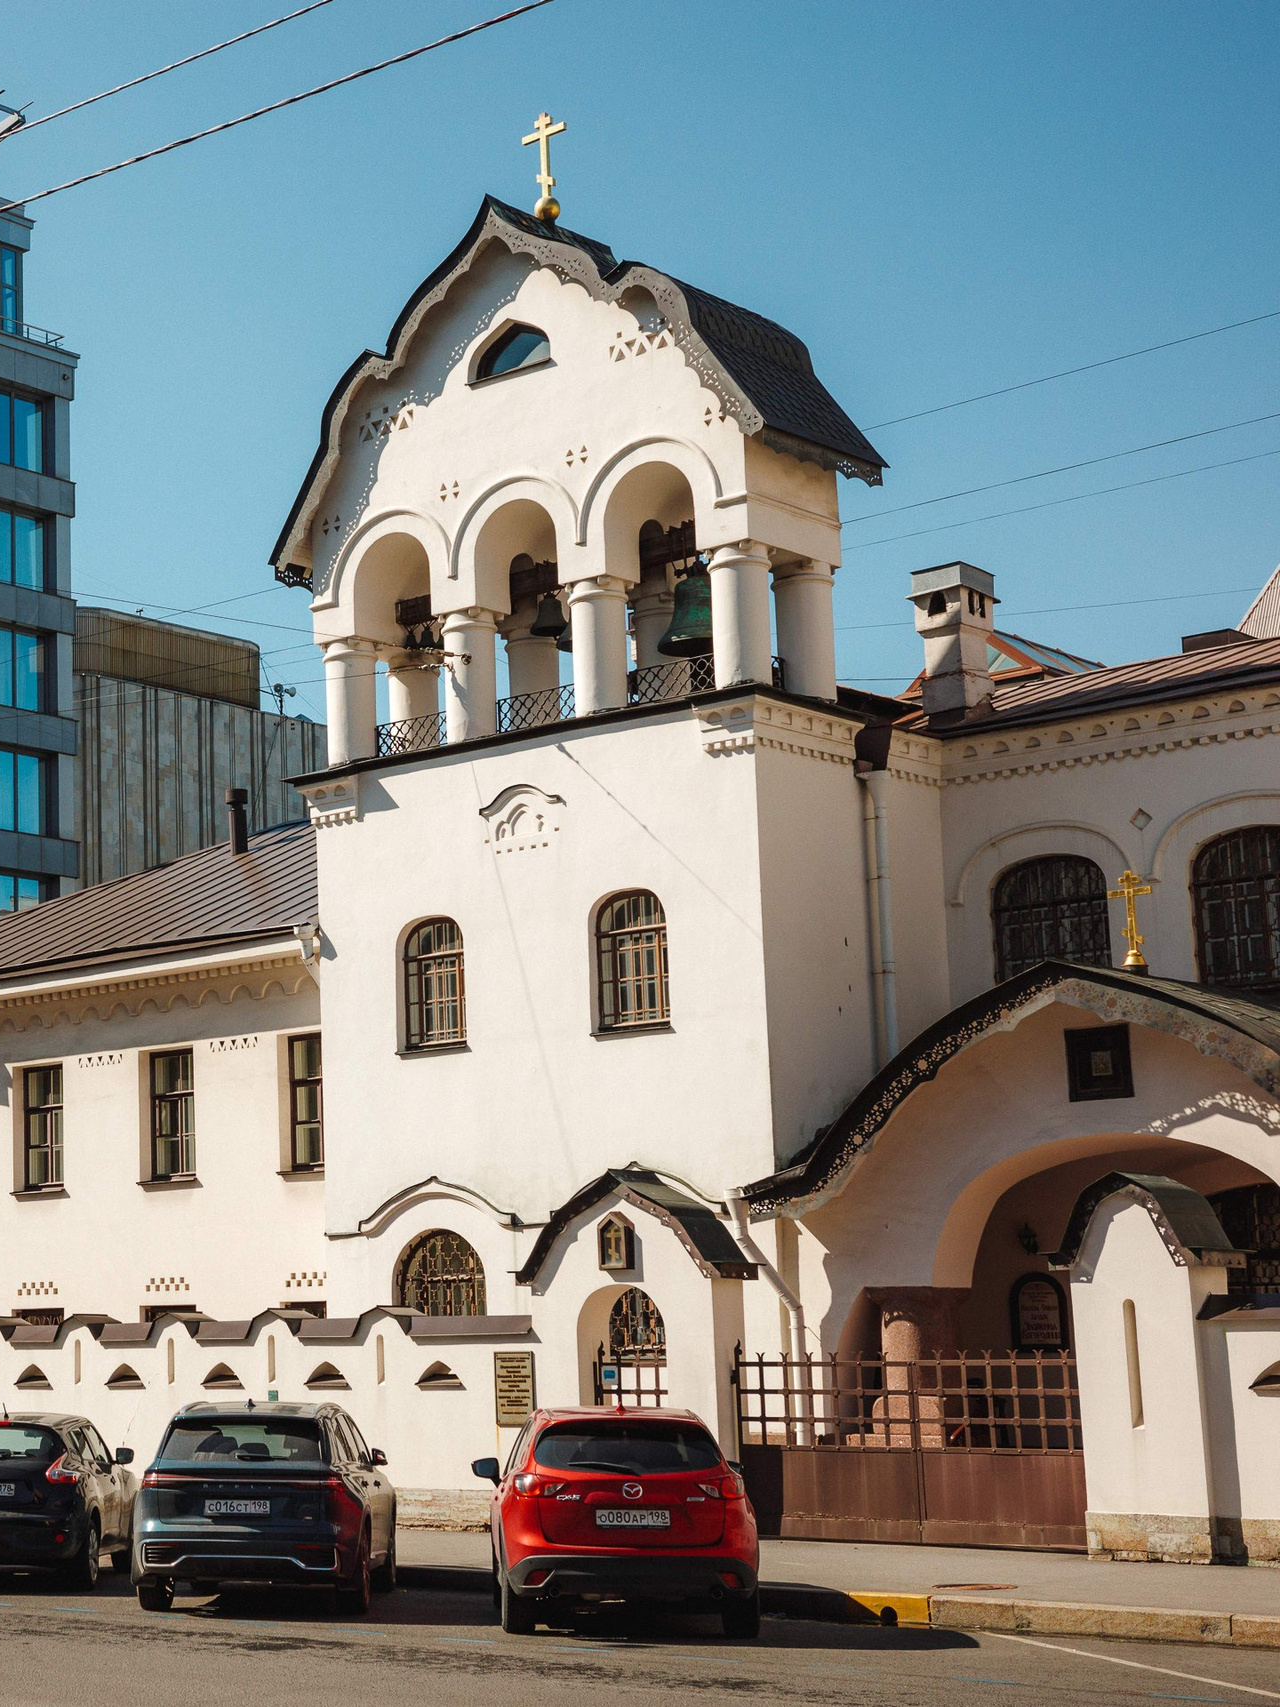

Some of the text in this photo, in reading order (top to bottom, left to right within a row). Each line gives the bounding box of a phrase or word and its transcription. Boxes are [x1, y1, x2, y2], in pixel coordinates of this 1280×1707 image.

[208, 1501, 268, 1512] С016СТ 198
[599, 1511, 647, 1524] О080АР
[649, 1511, 667, 1521] 198
